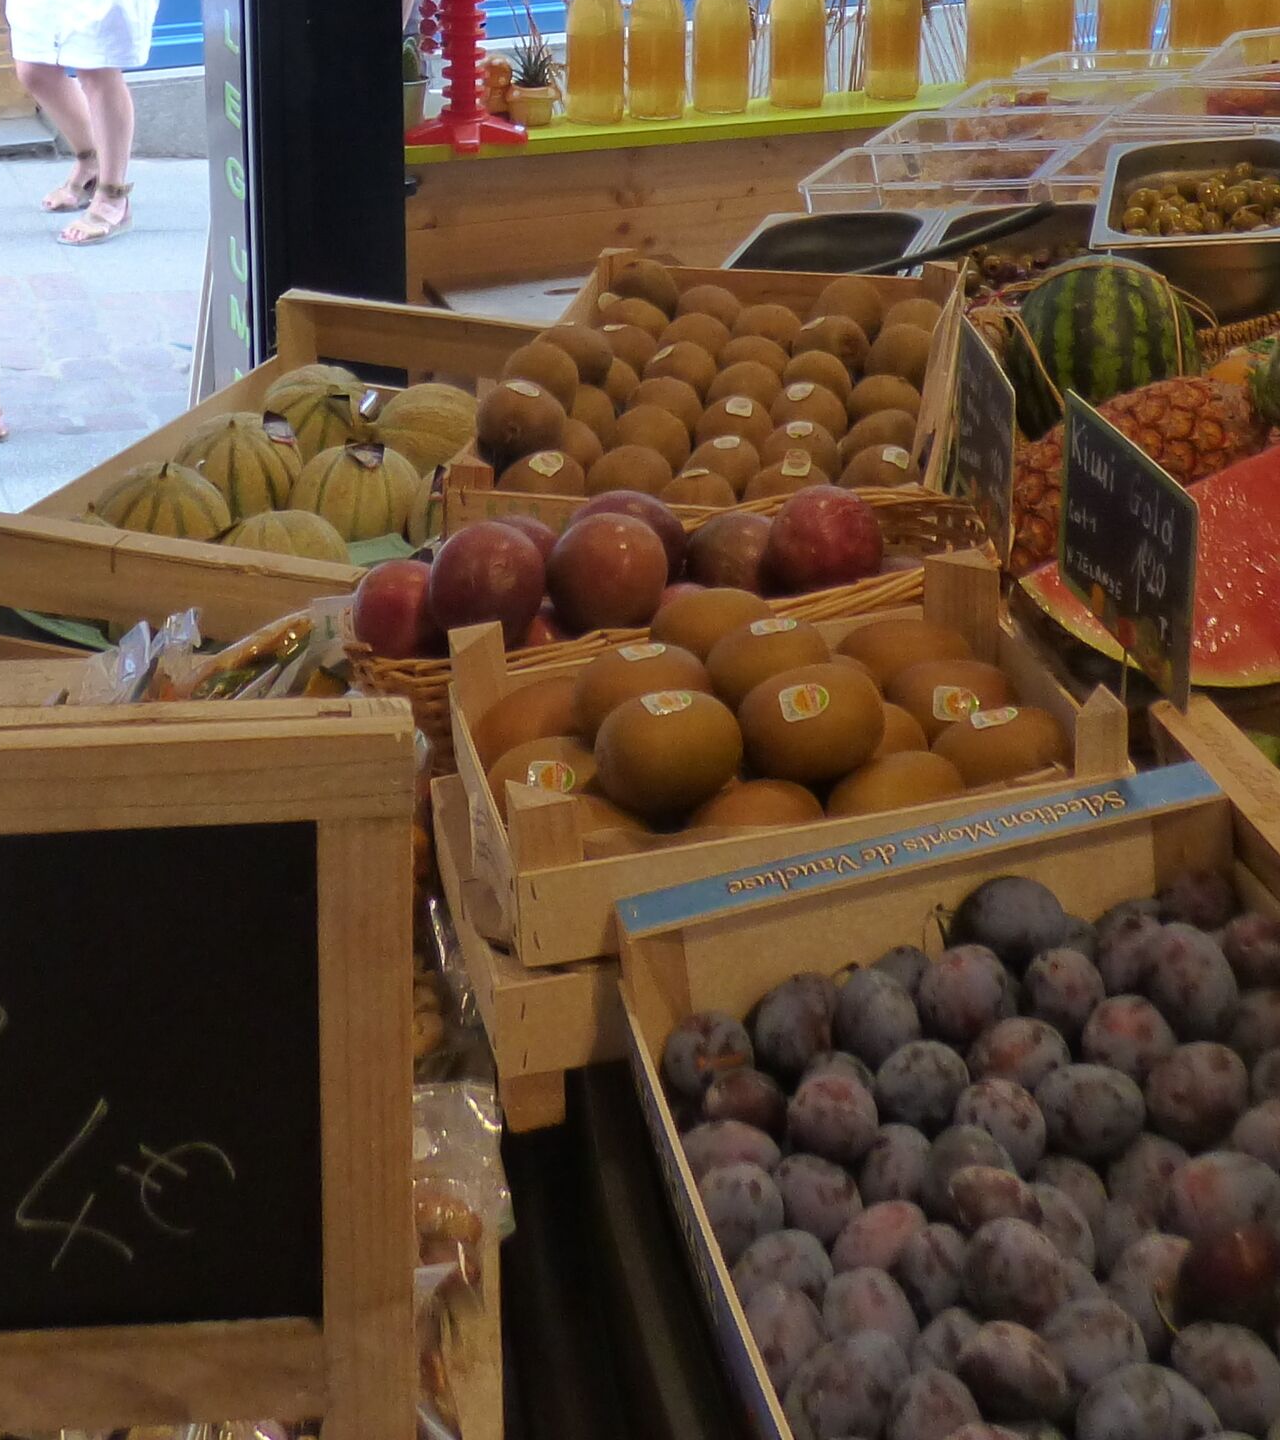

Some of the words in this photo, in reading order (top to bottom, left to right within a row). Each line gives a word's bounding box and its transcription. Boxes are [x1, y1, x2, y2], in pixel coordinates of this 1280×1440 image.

[1000, 789, 1128, 831] Sélection
[859, 841, 898, 869] de
[901, 817, 1001, 854] Monts
[726, 852, 861, 898] Vaucluse
